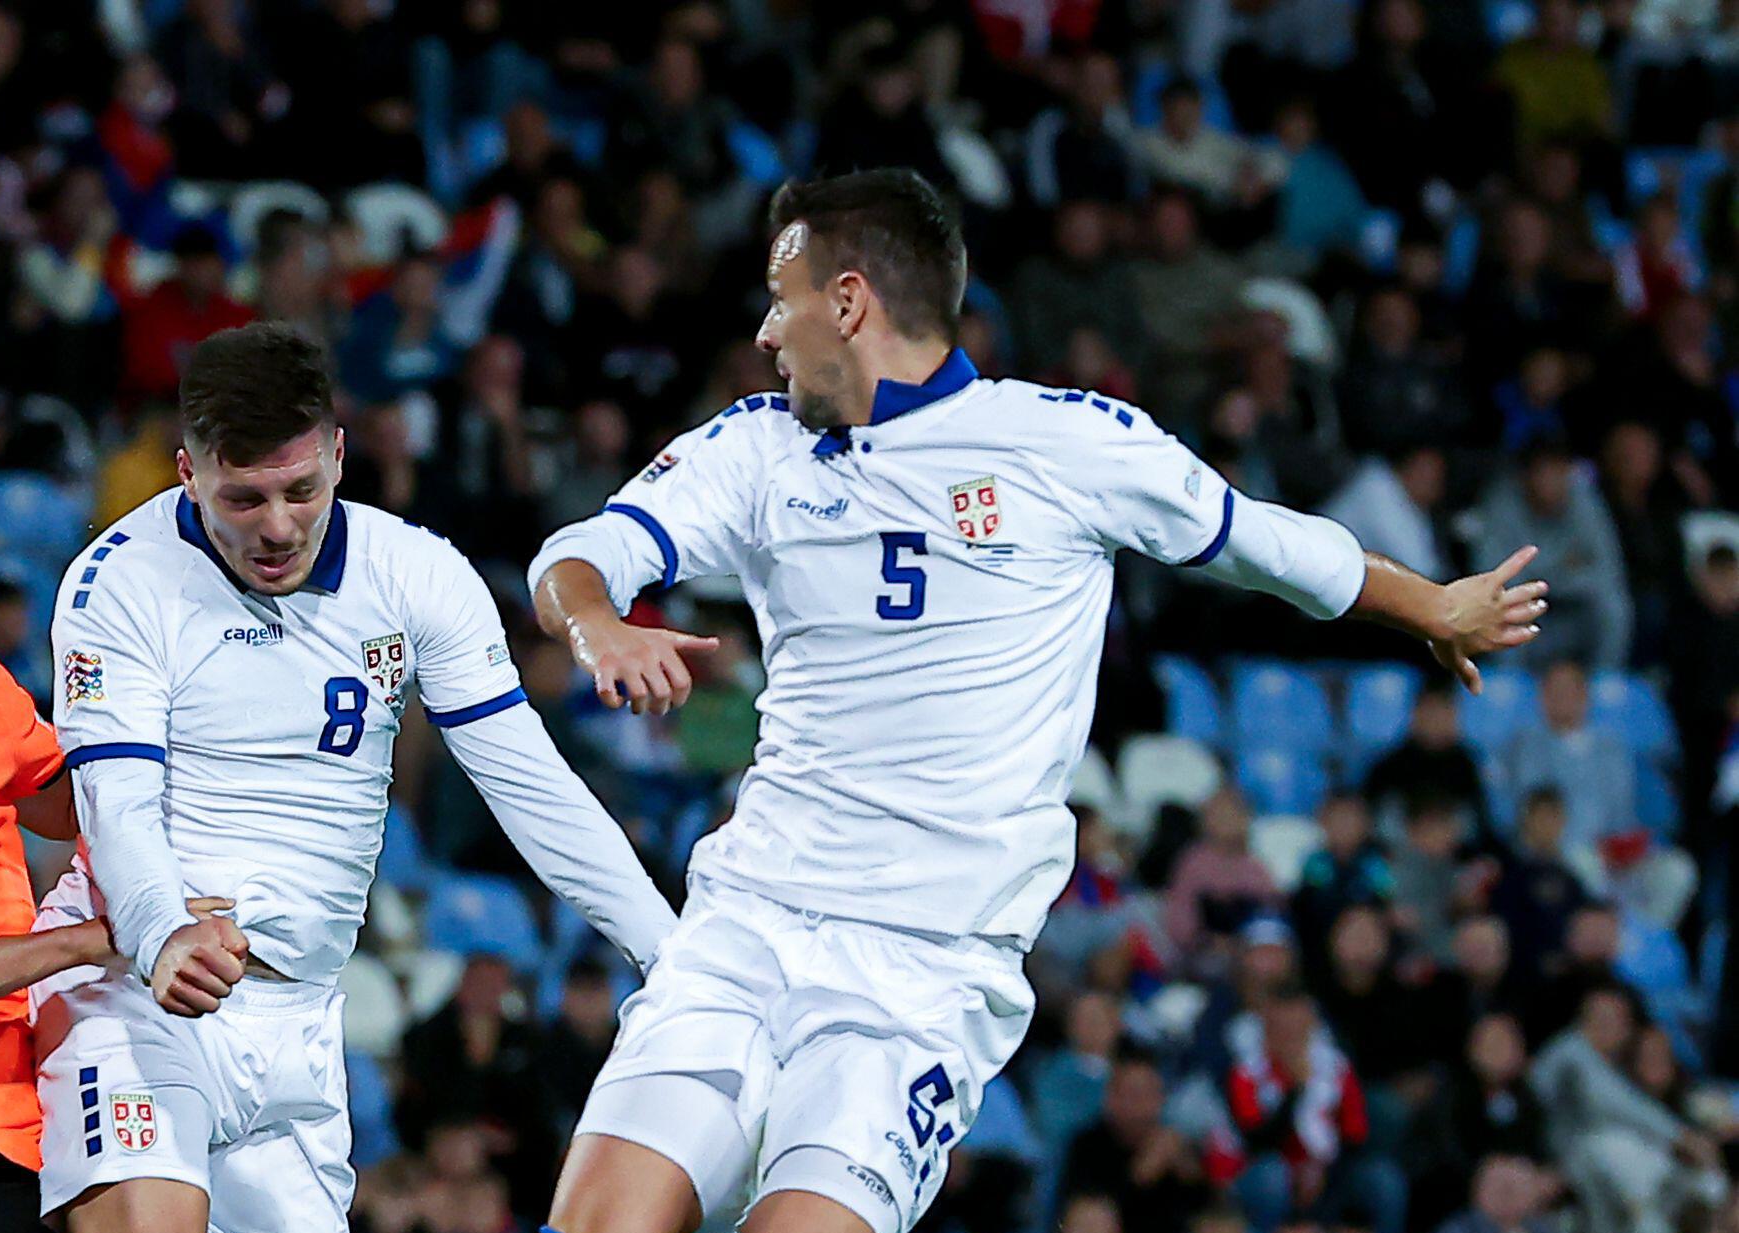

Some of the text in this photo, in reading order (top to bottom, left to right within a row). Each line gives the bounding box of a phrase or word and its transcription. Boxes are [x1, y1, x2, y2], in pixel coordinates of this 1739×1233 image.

[876, 531, 928, 620] 5
[223, 623, 283, 644] capelli
[317, 676, 369, 757] 8
